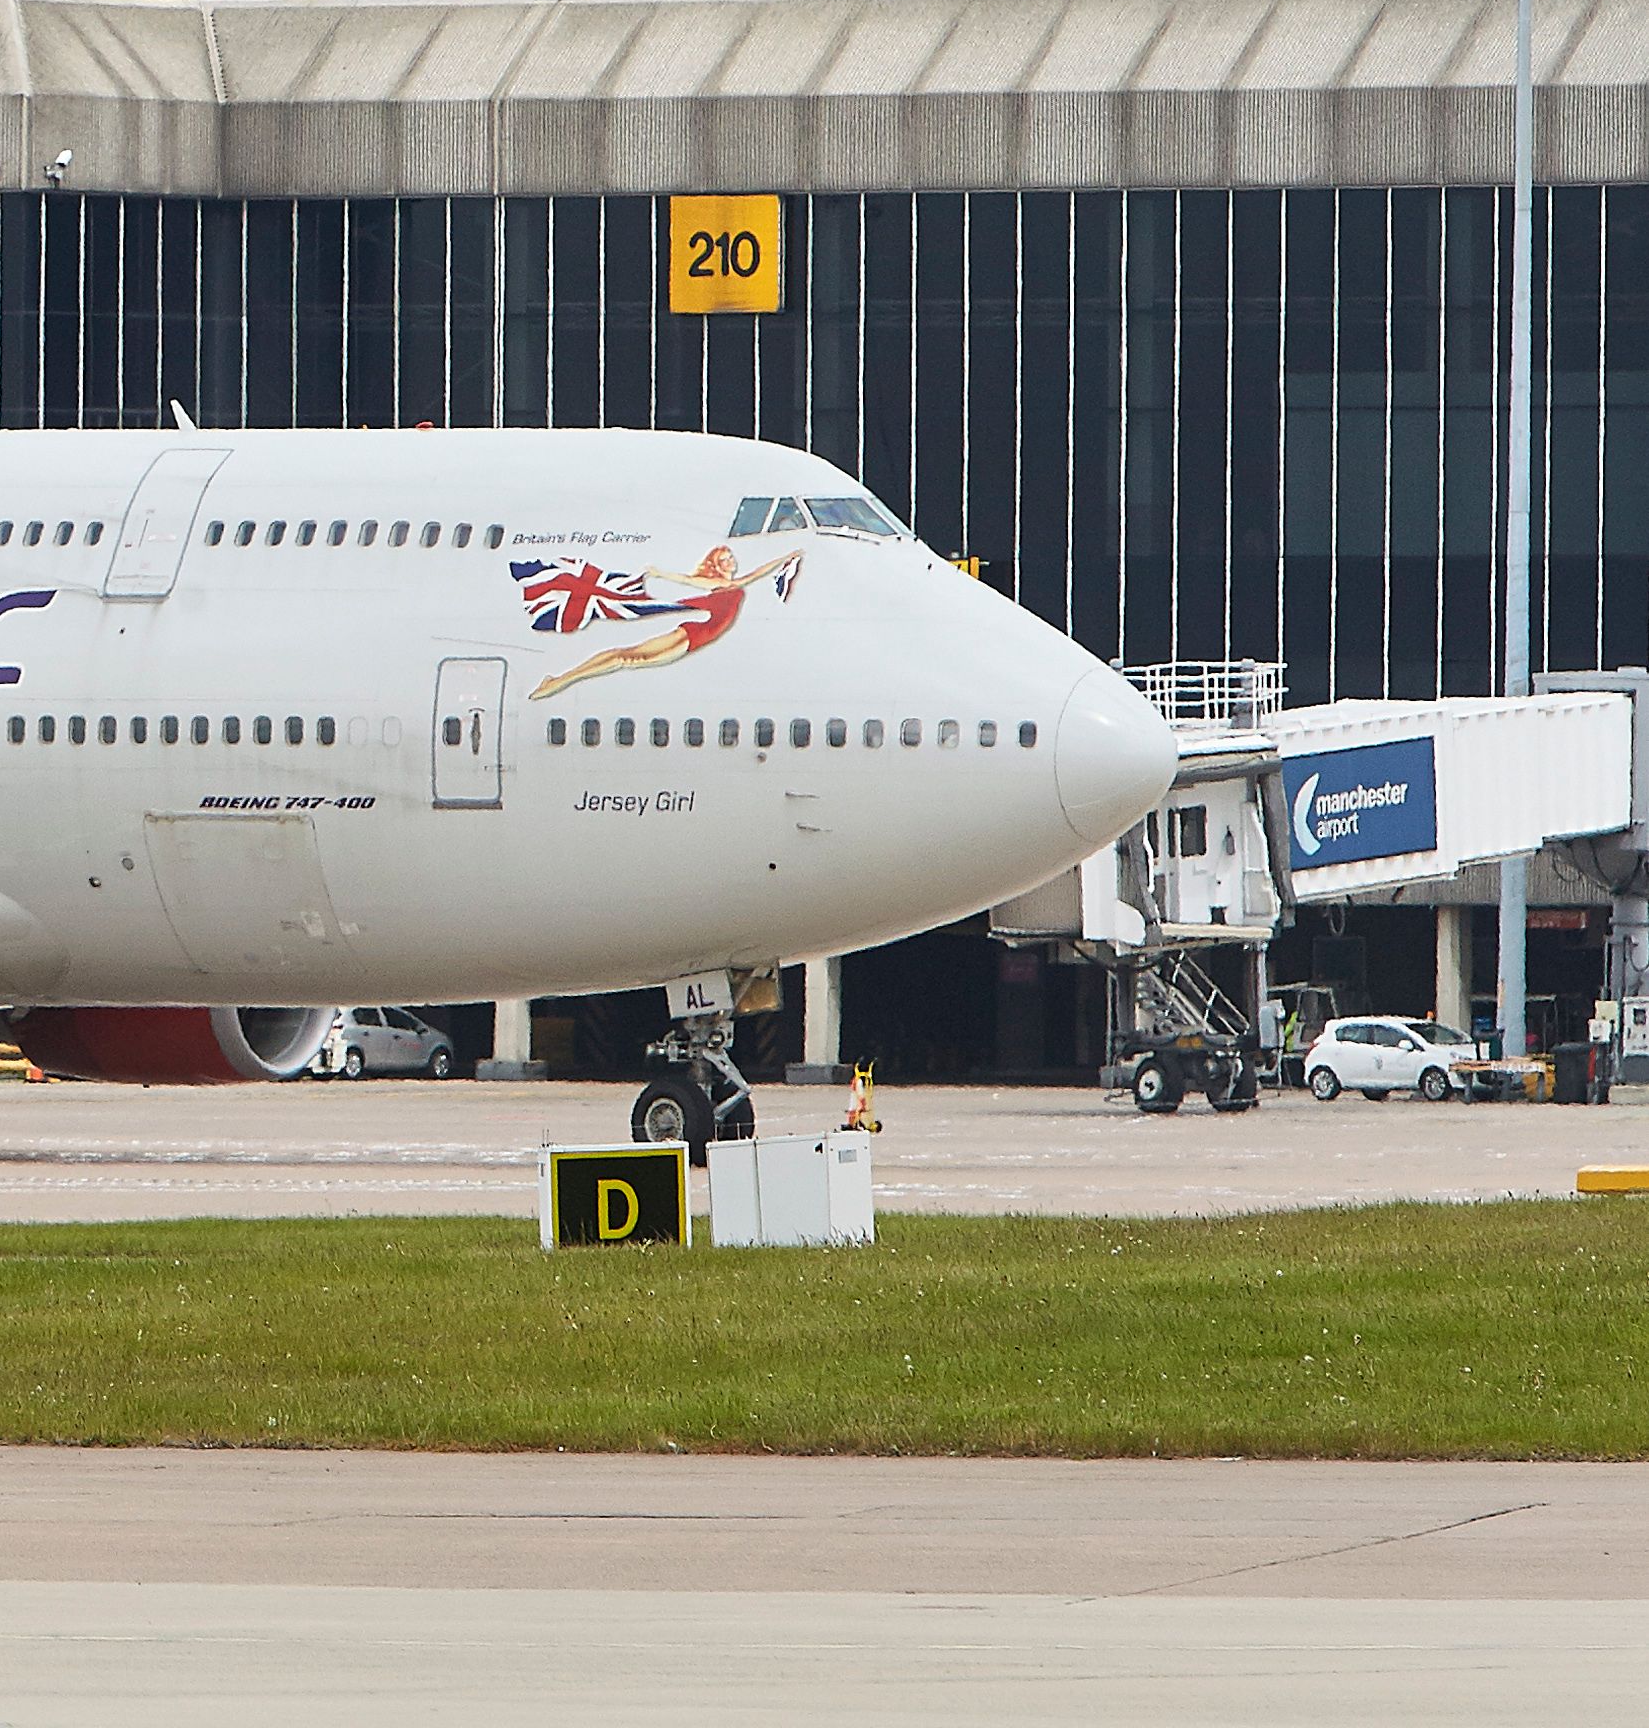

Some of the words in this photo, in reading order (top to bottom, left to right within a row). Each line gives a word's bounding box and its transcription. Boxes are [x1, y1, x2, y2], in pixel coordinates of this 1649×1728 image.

[688, 231, 761, 278] 210
[512, 531, 567, 545] Britain's
[570, 531, 598, 547] Flag
[601, 530, 652, 544] Carrier
[199, 795, 281, 810] BOEING
[284, 795, 377, 810] 747-400
[573, 789, 650, 817] Jersey
[655, 789, 696, 813] Girl
[1315, 780, 1410, 817] manchester
[1316, 811, 1360, 843] airport
[686, 982, 716, 1010] AL
[597, 1178, 640, 1240] D
